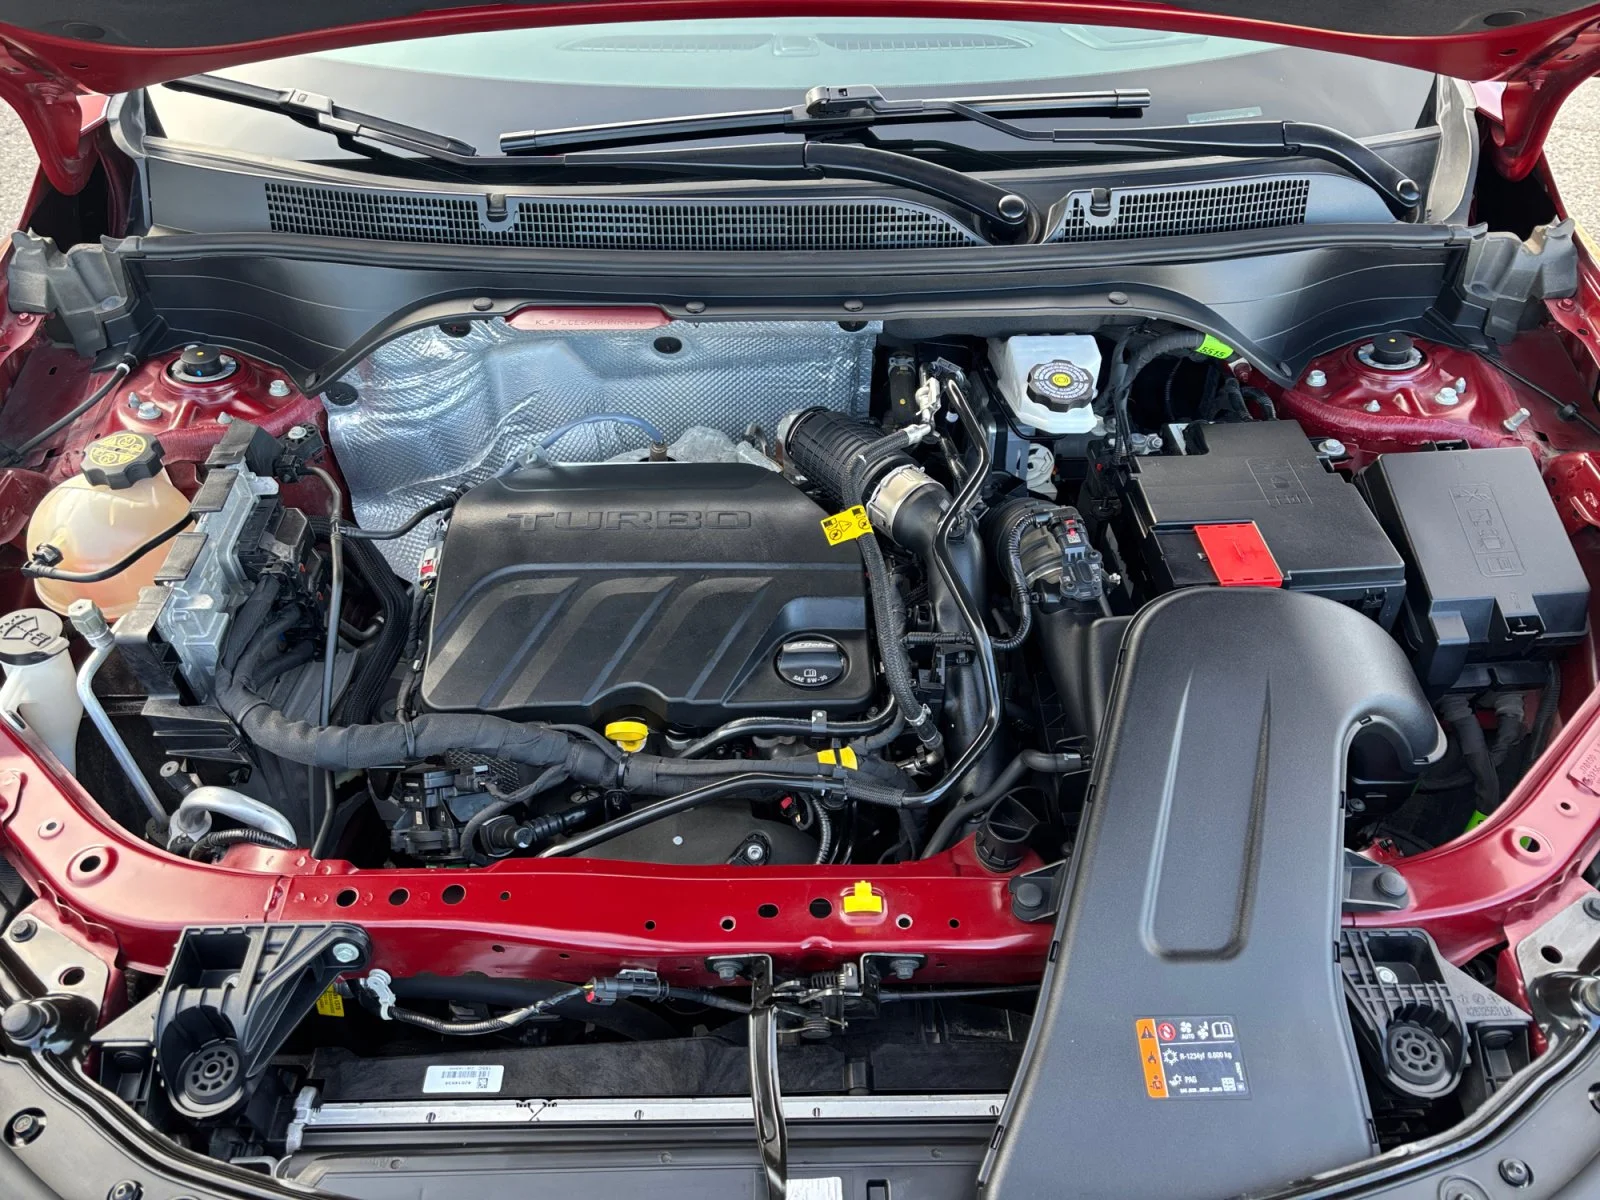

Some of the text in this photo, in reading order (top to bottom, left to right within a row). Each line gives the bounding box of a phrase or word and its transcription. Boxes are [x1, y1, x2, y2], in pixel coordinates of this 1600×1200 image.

[1201, 346, 1226, 358] 5515
[507, 510, 752, 532] TURBO
[792, 674, 805, 683] SAE
[1184, 1075, 1198, 1084] PAG
